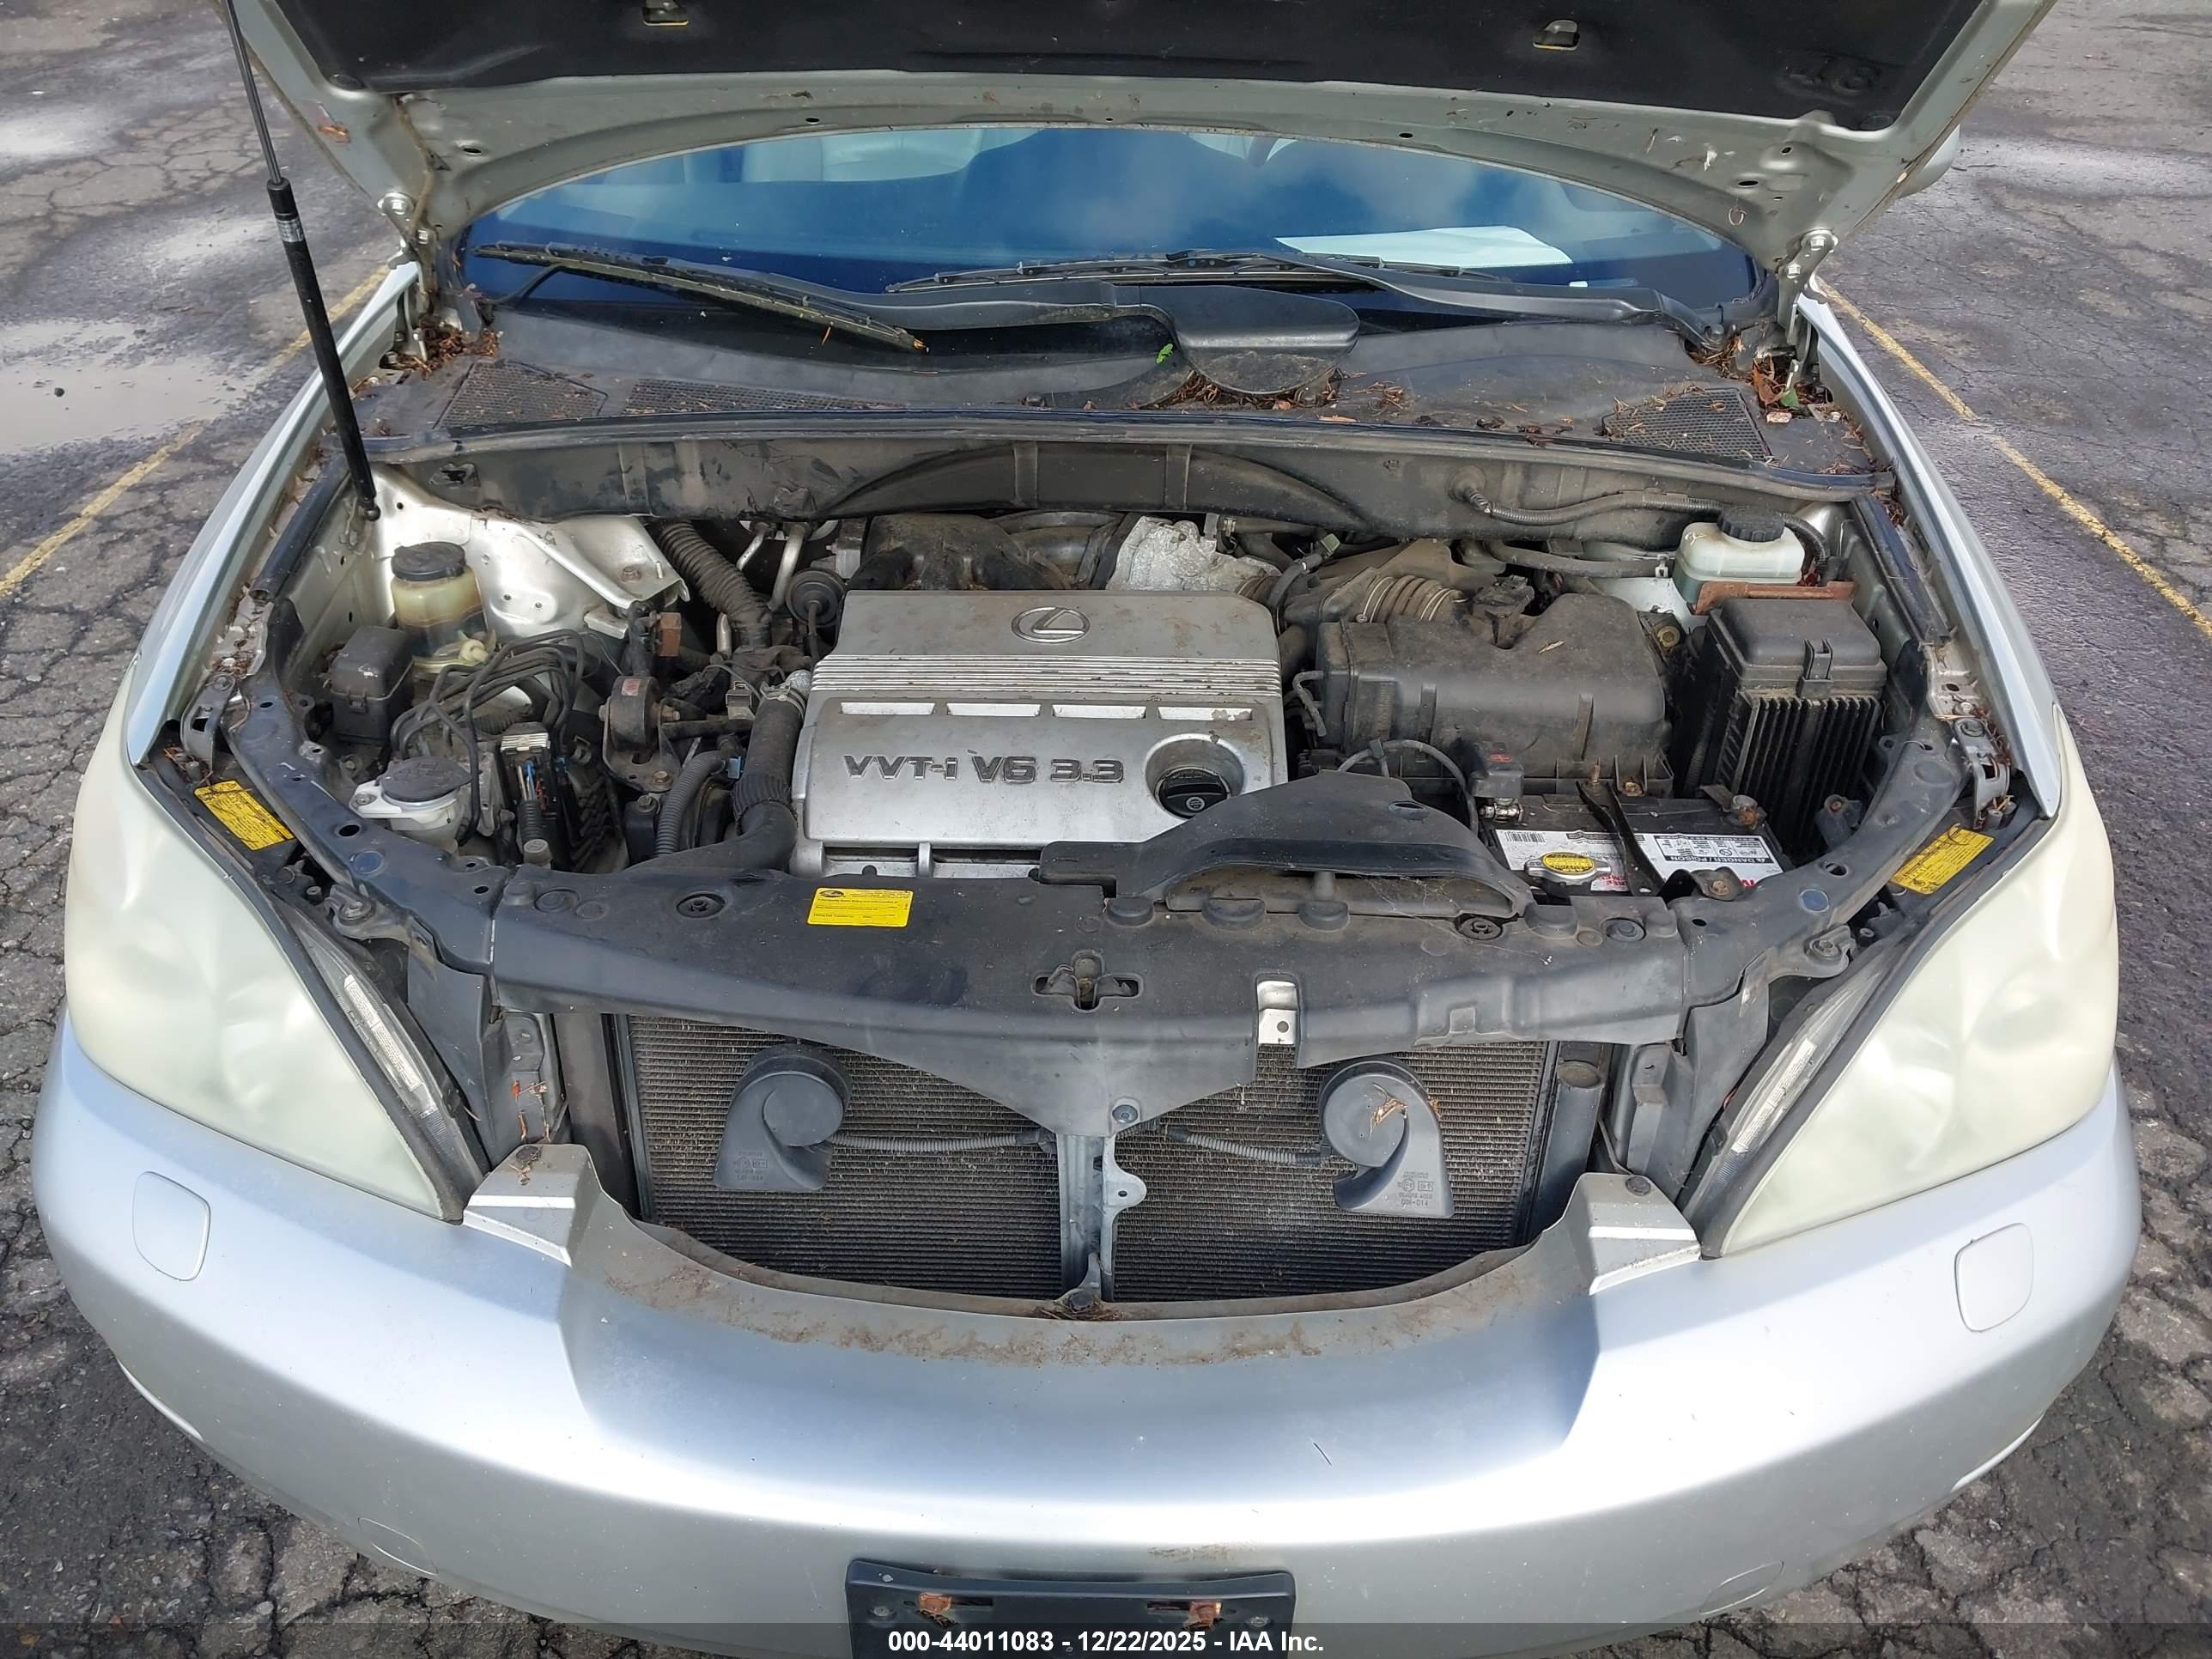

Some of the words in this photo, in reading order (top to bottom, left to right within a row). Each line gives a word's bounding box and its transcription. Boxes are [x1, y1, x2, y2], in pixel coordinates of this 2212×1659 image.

[843, 755, 958, 781] VVT-i
[971, 756, 1036, 783] V6
[1050, 758, 1124, 783] 3.3
